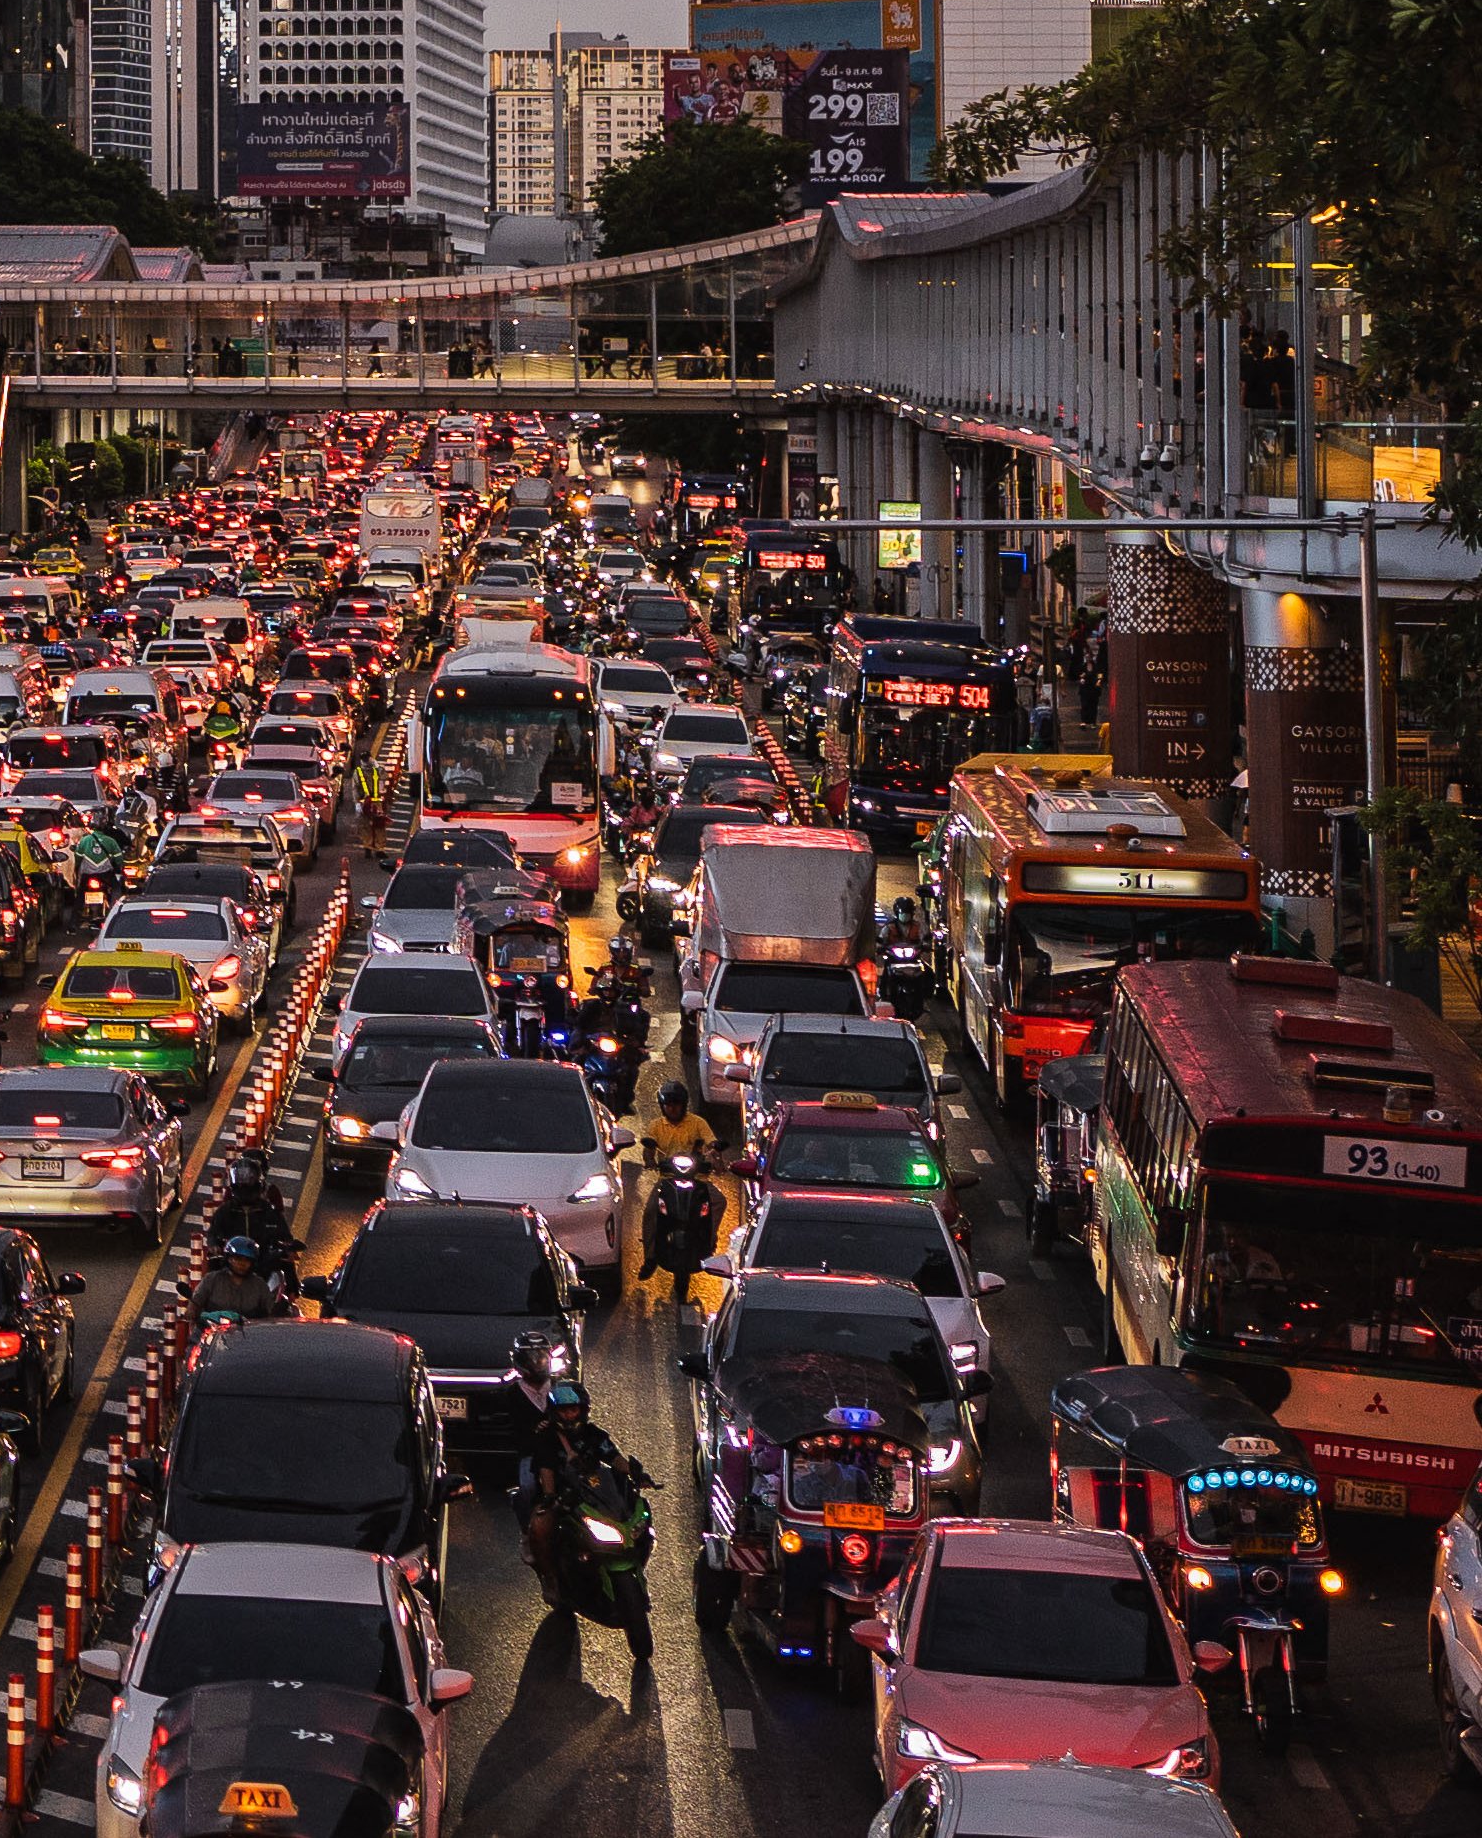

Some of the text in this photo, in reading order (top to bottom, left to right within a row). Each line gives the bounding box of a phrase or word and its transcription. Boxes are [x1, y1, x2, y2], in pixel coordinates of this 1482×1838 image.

[808, 94, 864, 120] 299
[810, 148, 864, 174] 199
[1147, 658, 1208, 672] GAYSORN
[1152, 675, 1203, 685] VILLAGE
[959, 683, 989, 708] 504
[1147, 709, 1188, 720] PARKING
[1157, 718, 1188, 729] VALET
[1166, 741, 1189, 759] IN
[1300, 742, 1361, 754] VILLAGE
[1292, 786, 1345, 797] PARKING
[1304, 796, 1345, 808] VALET
[1117, 871, 1155, 890] 511
[1347, 1143, 1441, 1183] 93 (1-40)
[1235, 1437, 1277, 1452] TAXI
[1314, 1442, 1456, 1471] MITSUBISHI
[233, 1789, 286, 1809] TAXI
